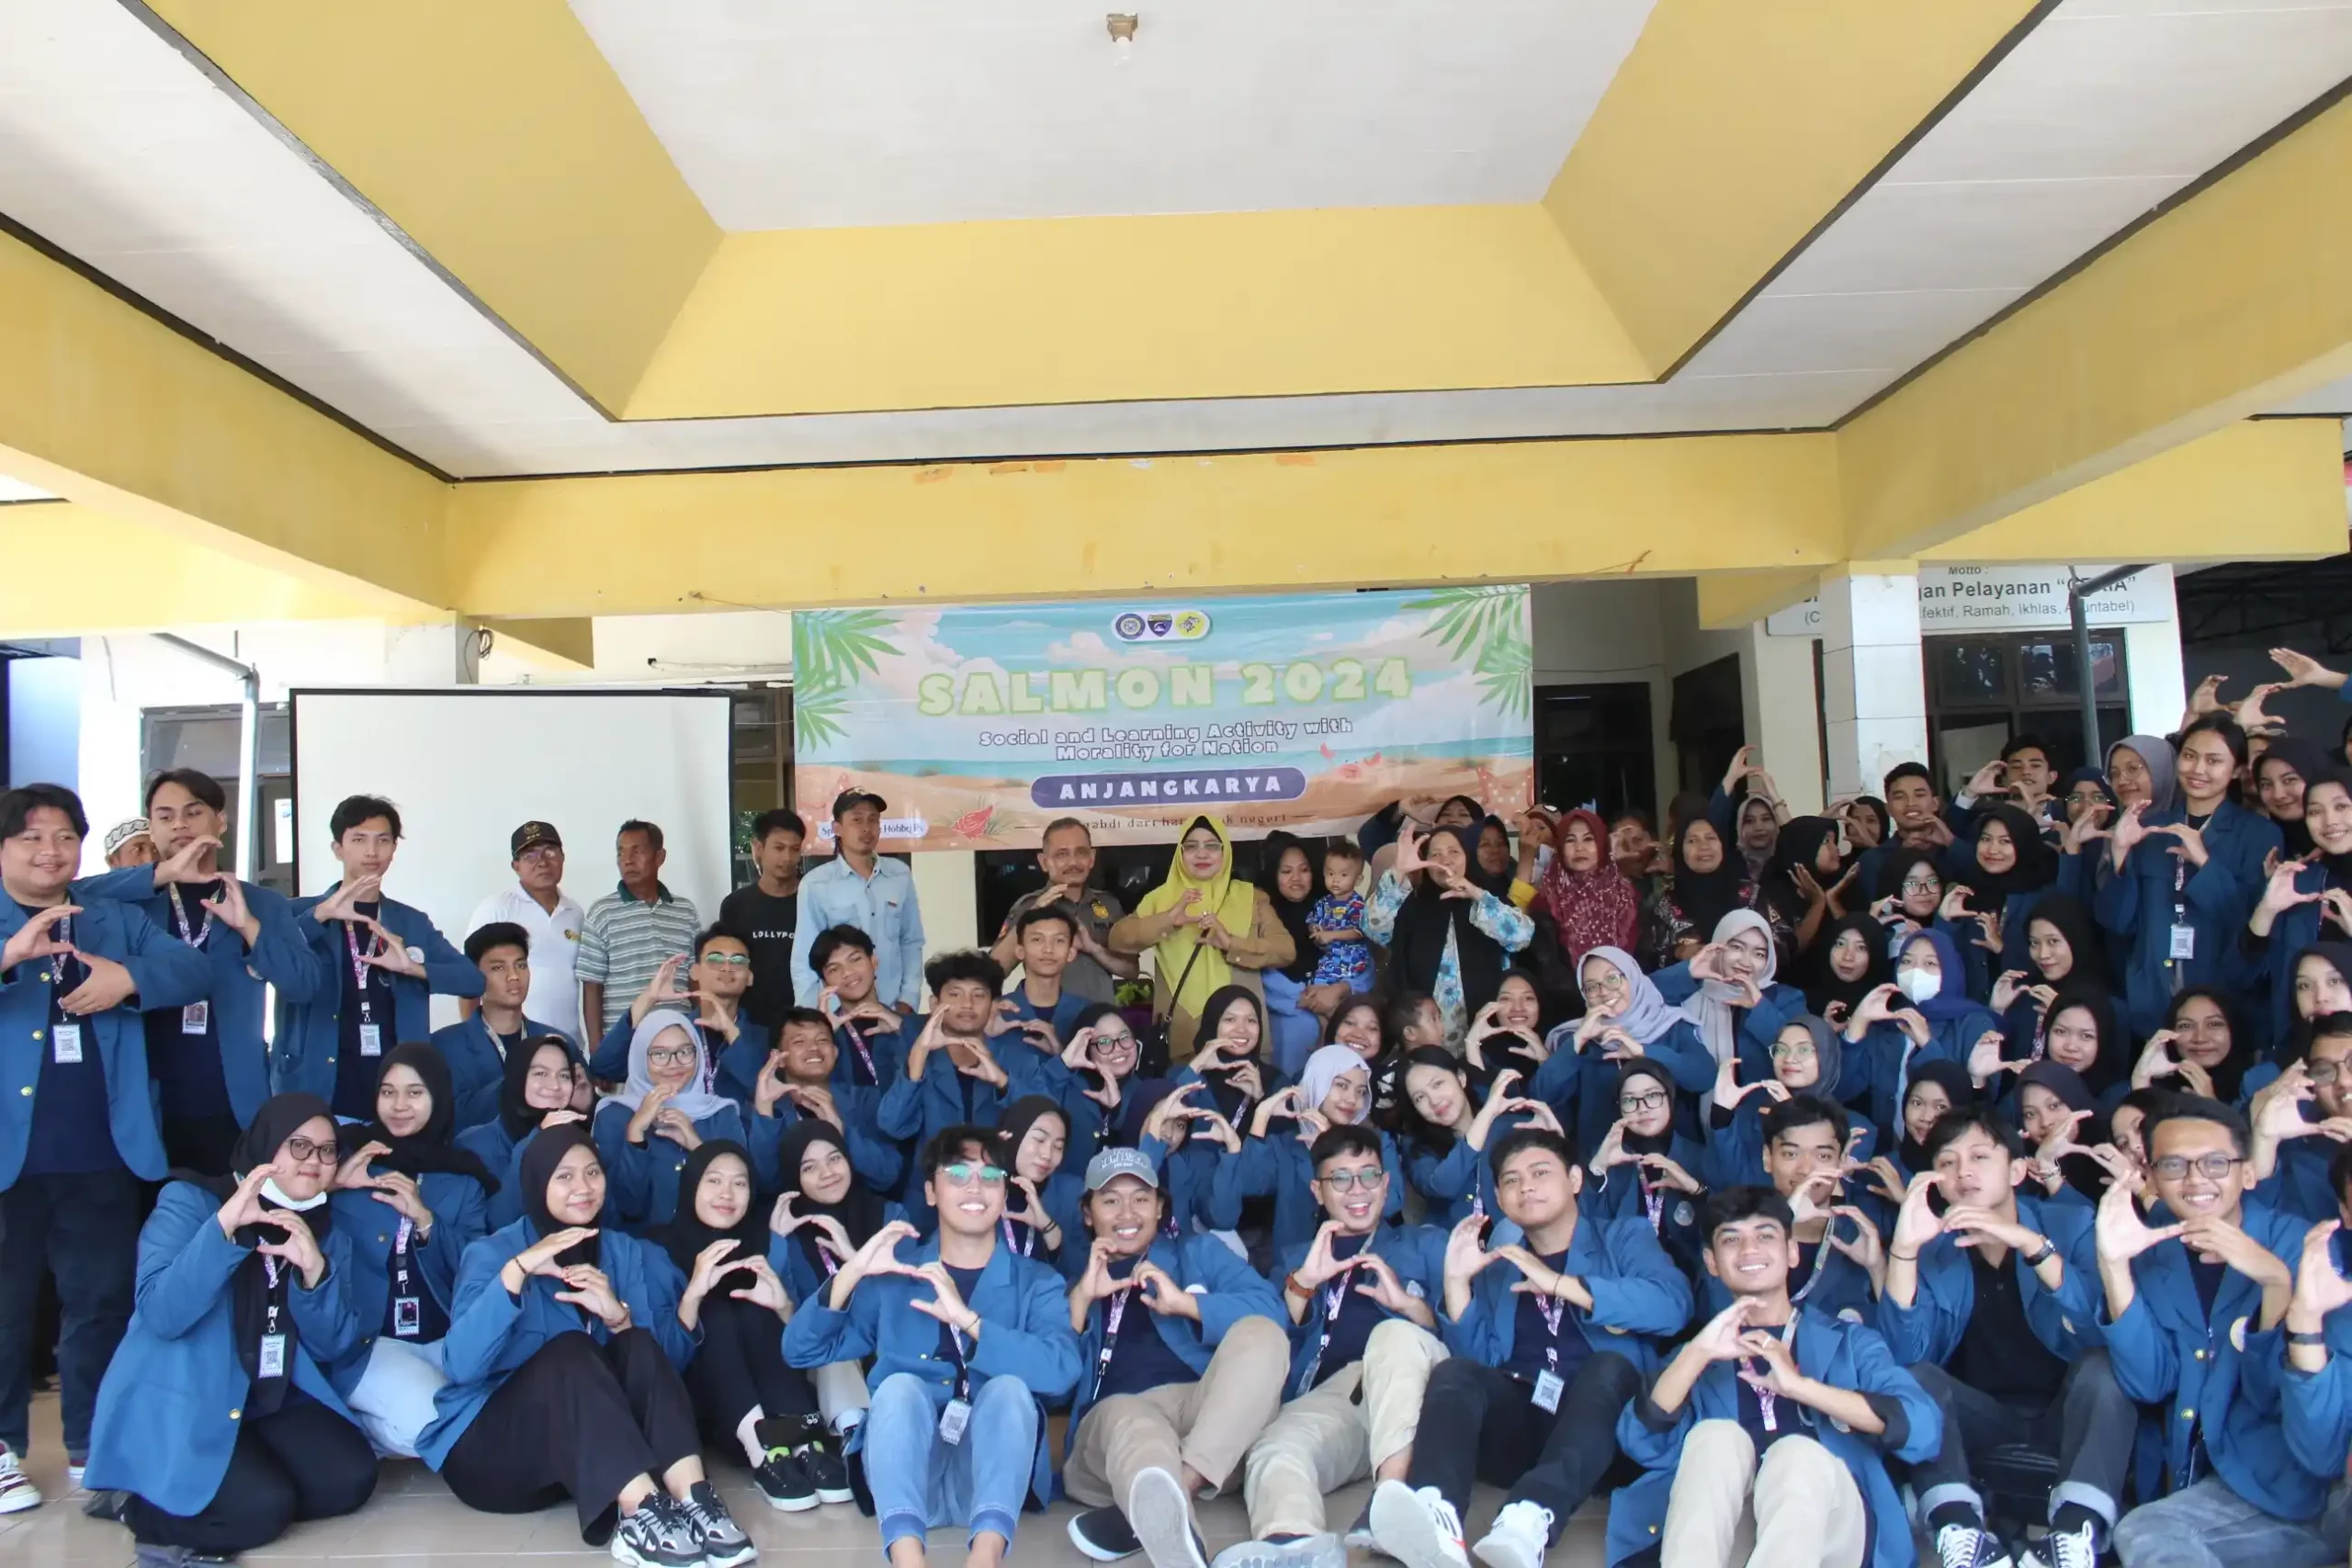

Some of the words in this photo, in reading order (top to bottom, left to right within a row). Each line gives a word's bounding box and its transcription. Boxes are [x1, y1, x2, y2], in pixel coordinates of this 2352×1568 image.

[1952, 581, 2052, 600] Pelayanan
[1920, 605, 1959, 619] fektif,
[1963, 604, 2015, 618] Ramah,
[2018, 603, 2062, 615] Ikhlas,
[918, 663, 1215, 716] SALMON
[1240, 657, 1412, 705] 2024
[979, 728, 1048, 746] Social
[1055, 728, 1095, 744] and
[1102, 724, 1201, 744] Learning
[1206, 720, 1297, 740] Activity
[1304, 717, 1353, 735] with
[1056, 742, 1155, 762] Morality
[1160, 741, 1196, 757] for
[1202, 739, 1279, 756] Nation
[1059, 775, 1282, 800] ANJANGKARYA
[884, 823, 911, 835] Hobby
